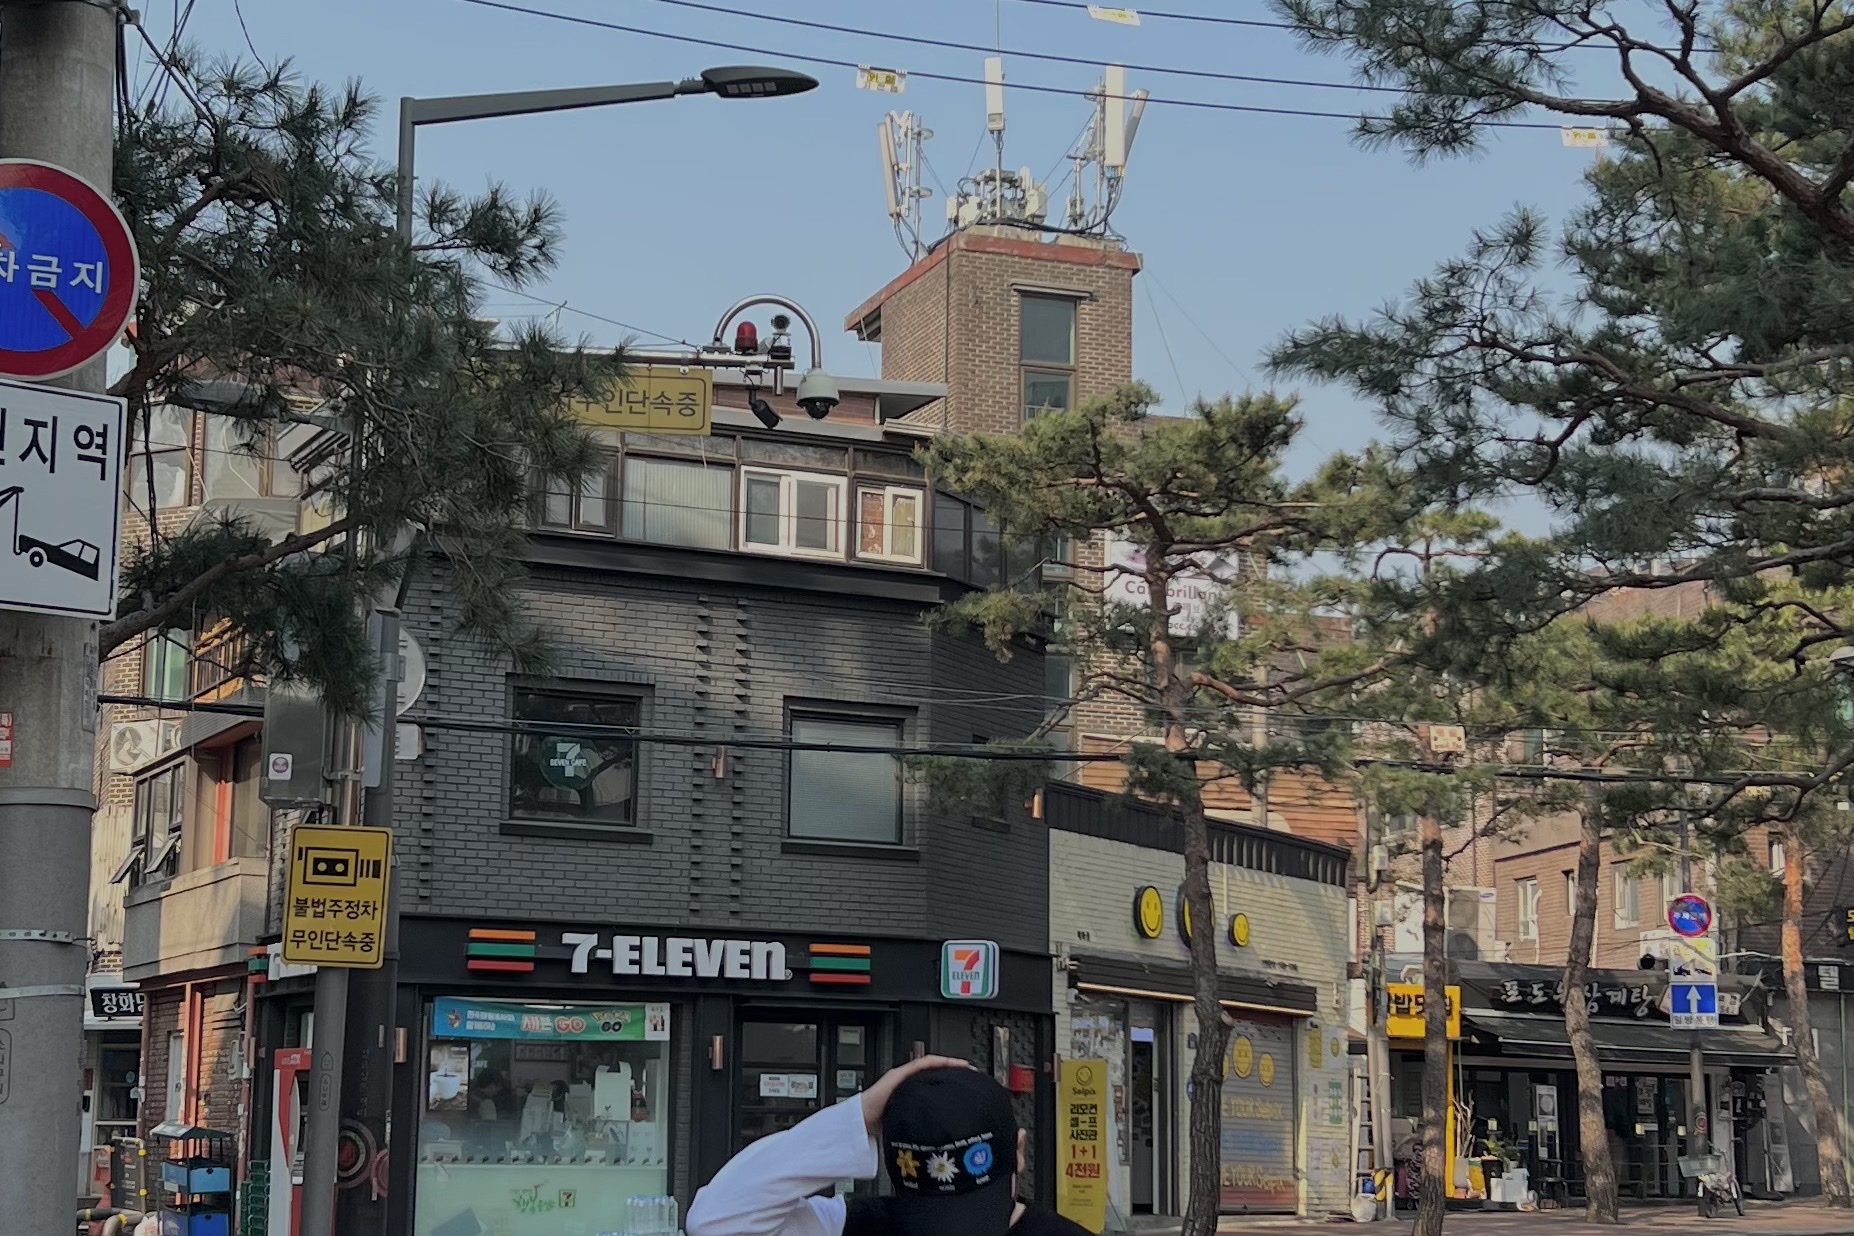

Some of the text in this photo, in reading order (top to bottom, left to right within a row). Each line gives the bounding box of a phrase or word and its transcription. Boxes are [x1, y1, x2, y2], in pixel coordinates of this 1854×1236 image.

[292, 896, 379, 921] 불법주정차
[289, 929, 376, 953] 무인단속중
[1065, 1162, 1101, 1179] 4천원
